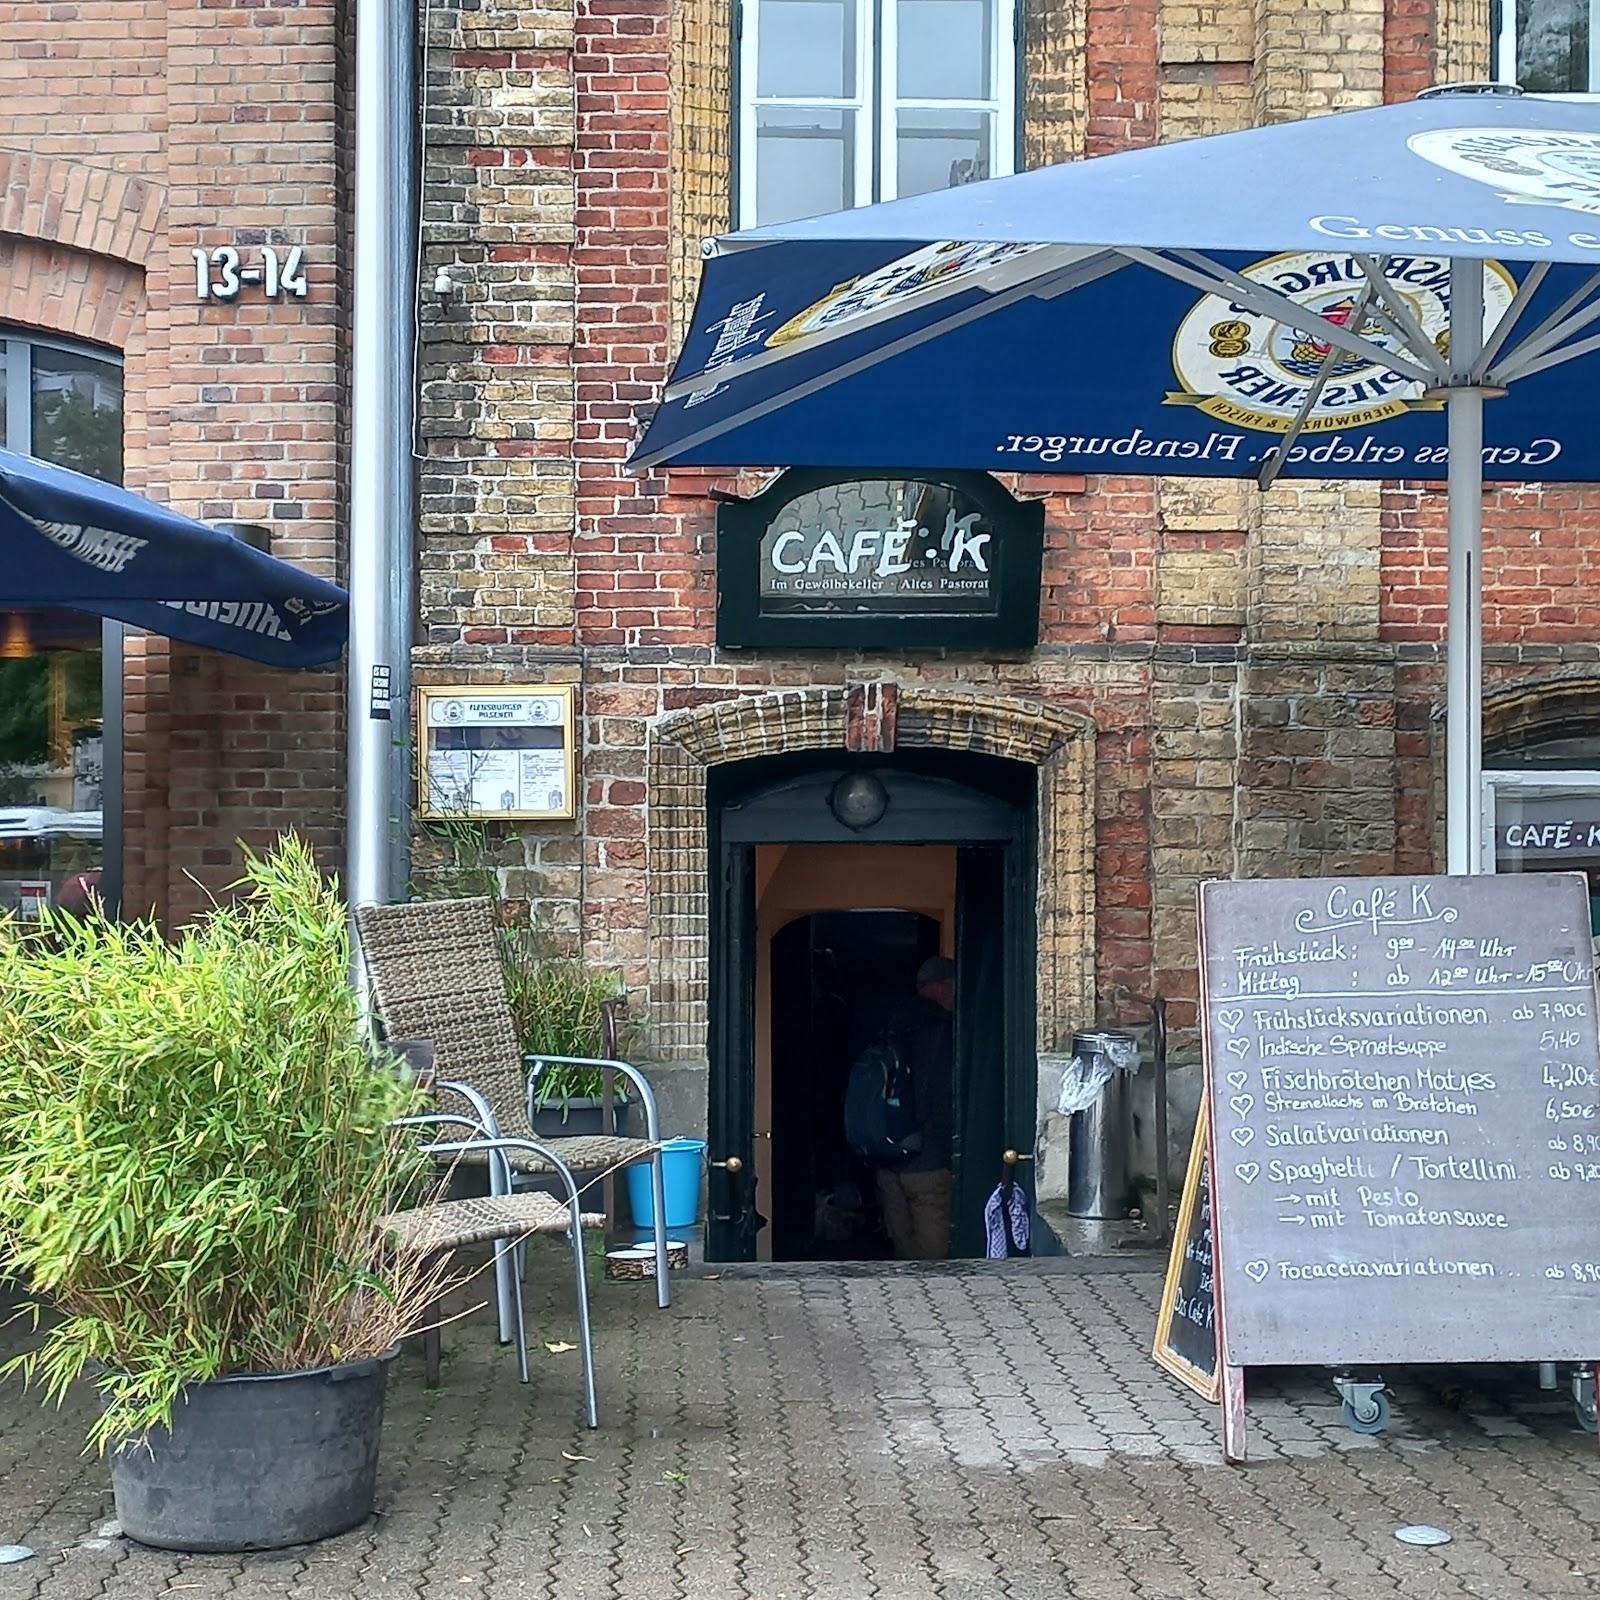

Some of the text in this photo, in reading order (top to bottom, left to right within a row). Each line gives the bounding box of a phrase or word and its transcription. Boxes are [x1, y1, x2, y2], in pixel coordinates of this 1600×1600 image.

[1308, 214, 1553, 247] Genuss
[191, 245, 307, 299] 13-14
[771, 518, 991, 577] CAFÉ K
[771, 578, 989, 590] Im Gewölbekeller Altes Pastorat
[1506, 819, 1573, 849] CAFÉ
[1327, 883, 1433, 936] Café K
[1479, 937, 1517, 958] Uhr
[1237, 971, 1300, 1000] Mittag
[1387, 963, 1410, 985] ab
[1475, 968, 1513, 985] Uhr
[1513, 1003, 1534, 1020] ab
[1538, 1003, 1587, 1023] 7,90€
[1258, 1035, 1327, 1058] Indische
[1539, 1030, 1580, 1051] 5,40
[1261, 1064, 1411, 1092] Fischbrötchen
[1264, 1091, 1595, 1123] Stremellachs im Brötchen 6,50€
[1264, 1123, 1449, 1147] Salatvariationen
[1548, 1133, 1568, 1152] ab
[1267, 1156, 1376, 1185] Spaghetti
[1549, 1161, 1570, 1180] ab
[1306, 1184, 1419, 1207] mit Pesto
[1310, 1205, 1508, 1228] mit Tomatensauce
[1545, 1264, 1565, 1279] ab
